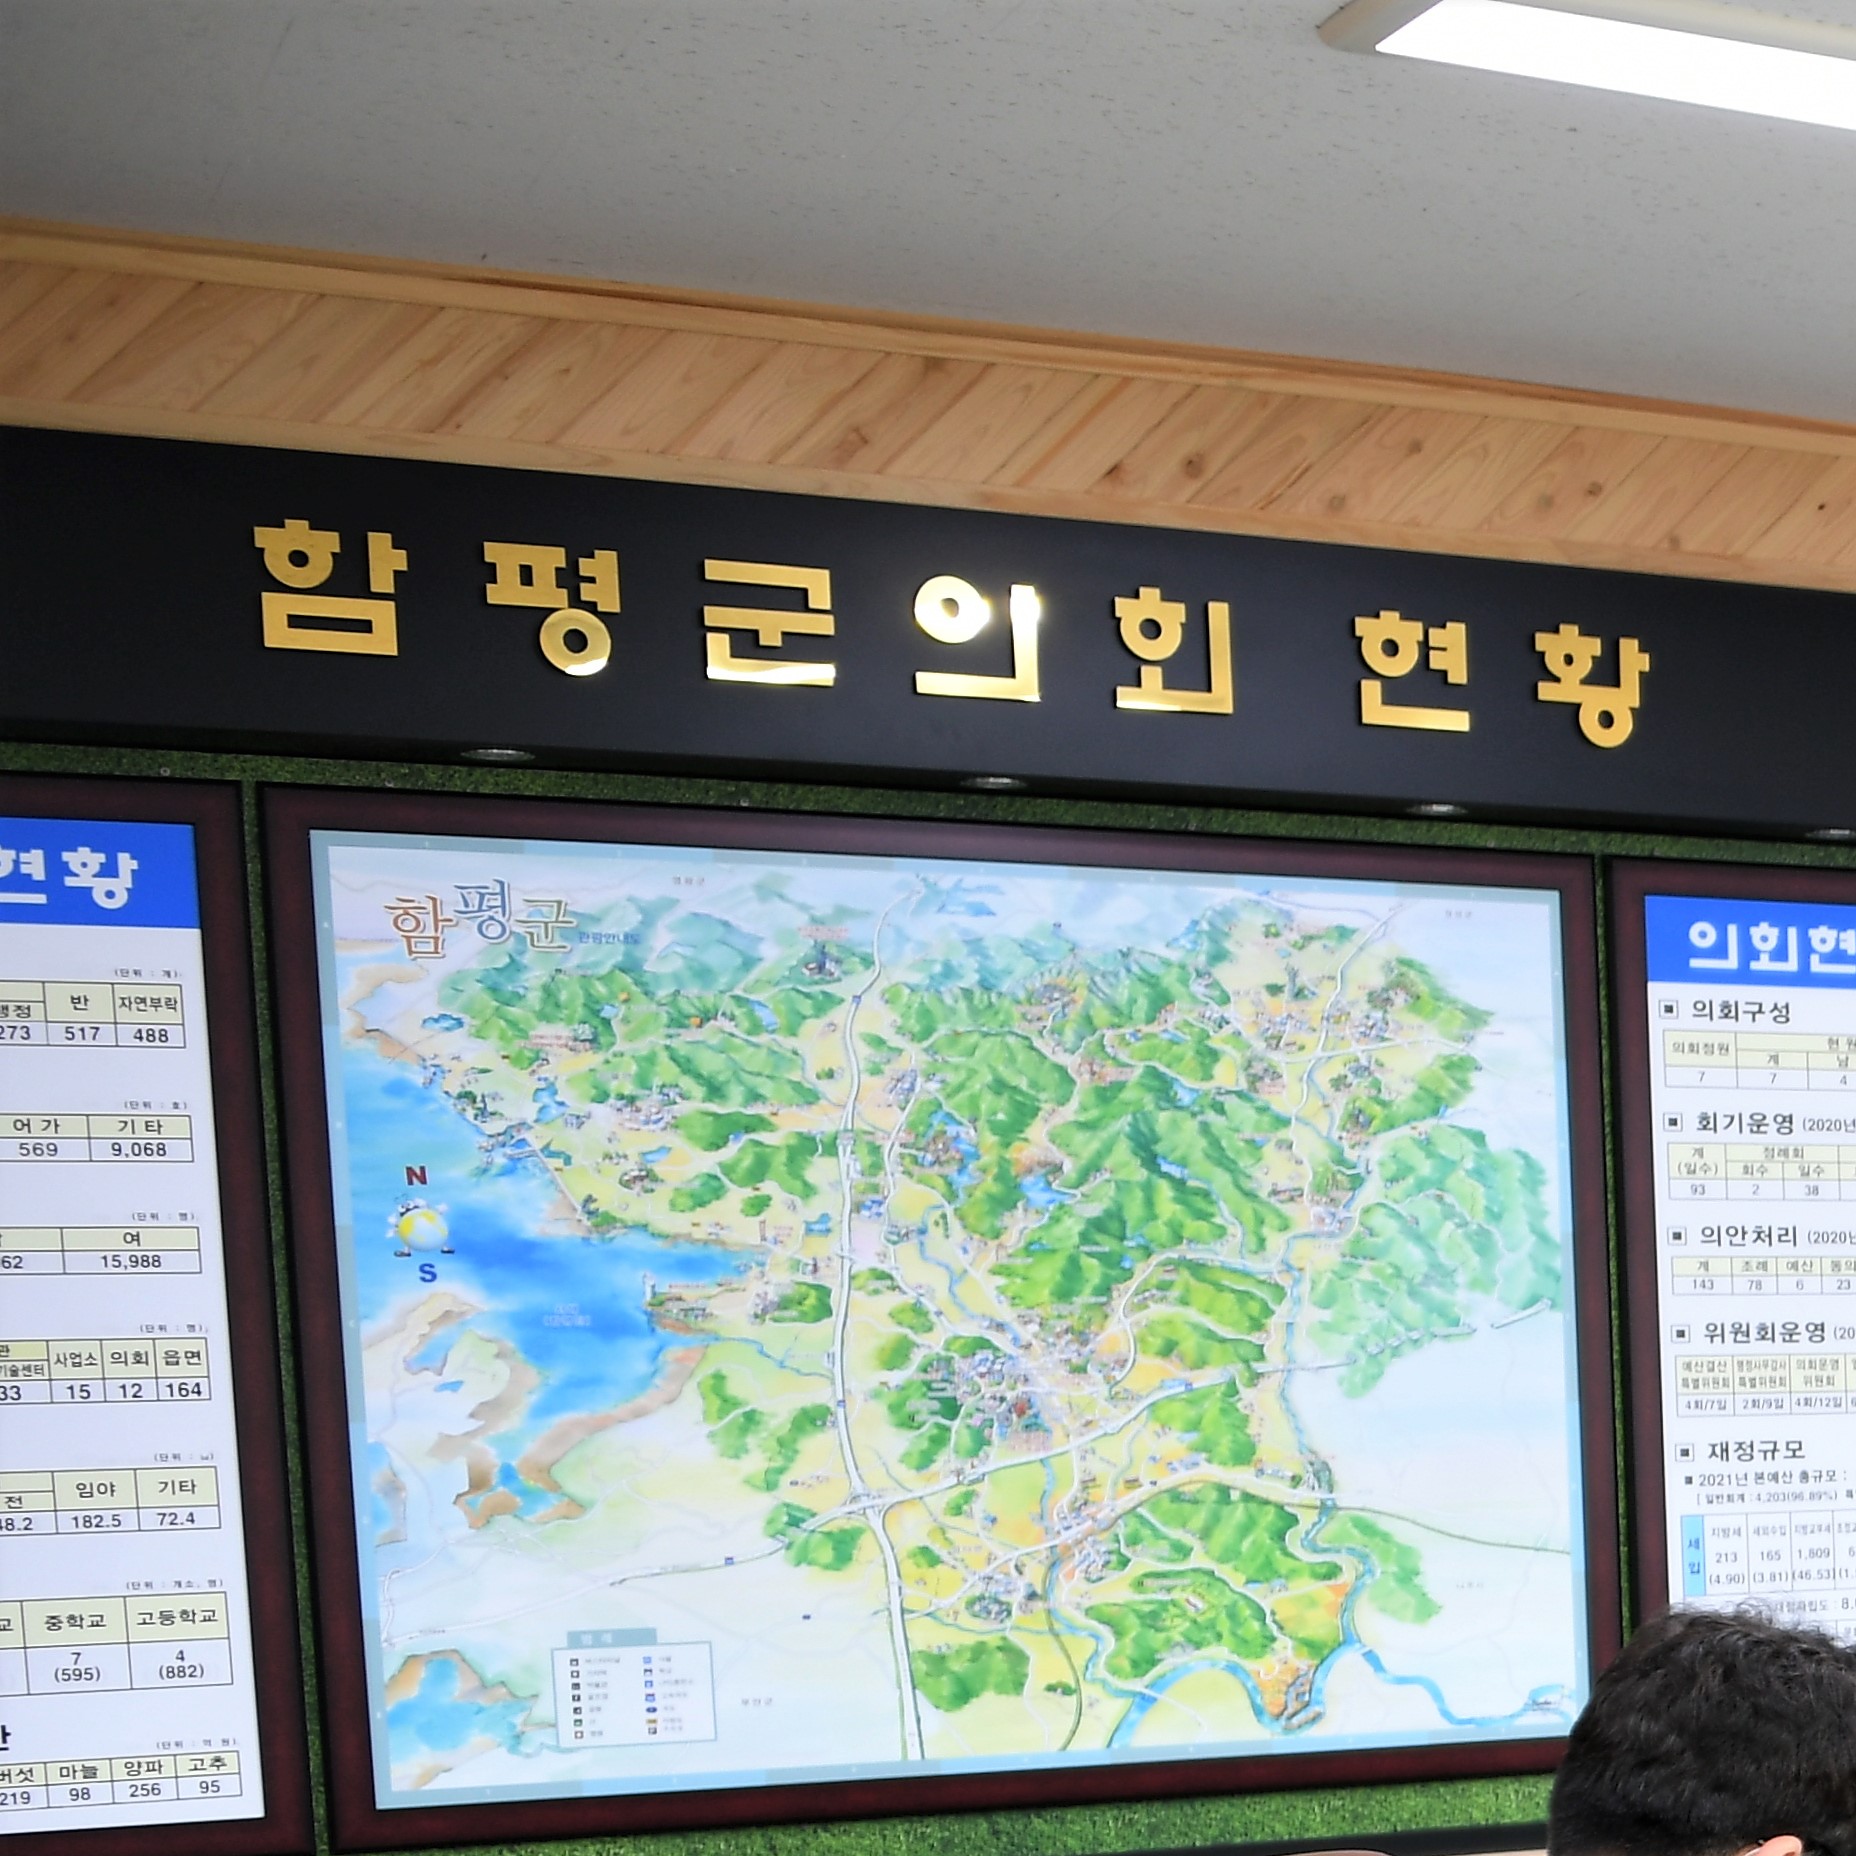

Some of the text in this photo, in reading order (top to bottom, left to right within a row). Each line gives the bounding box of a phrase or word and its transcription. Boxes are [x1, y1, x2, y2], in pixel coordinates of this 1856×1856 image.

[254, 520, 1652, 748] 함평군의회 현황
[383, 878, 578, 960] 함평군
[71, 995, 89, 1011] 반
[119, 996, 178, 1012] 자연부락
[1692, 1000, 1791, 1024] 의회구성
[65, 1026, 100, 1040] 517
[133, 1028, 169, 1043] 488
[1839, 1074, 1848, 1086] 4
[1696, 1111, 1794, 1134] 회기운영
[19, 1142, 58, 1156] 569
[111, 1142, 167, 1158] 9,068
[406, 1165, 428, 1186] N
[1690, 1184, 1706, 1196] 93
[1752, 1184, 1760, 1196] 2
[1805, 1184, 1819, 1196] 38
[123, 1231, 141, 1247] 여
[1700, 1225, 1798, 1248] 의안처리
[101, 1255, 162, 1269] 15,988
[419, 1263, 437, 1282] S
[1692, 1279, 1714, 1290] 143
[1748, 1279, 1762, 1290] 78
[1836, 1279, 1851, 1290] 23
[1704, 1321, 1826, 1344] 위원회운영
[54, 1353, 98, 1368] 사업소
[110, 1350, 149, 1367] 의회
[162, 1350, 201, 1366] 읍면
[66, 1384, 91, 1399] 15
[119, 1384, 143, 1399] 12
[165, 1382, 202, 1398] 164
[1708, 1440, 1806, 1462] 재정규모
[158, 1480, 197, 1495] 기타
[1698, 1474, 1748, 1487] 2021년
[75, 1482, 115, 1498] 임야
[4, 1496, 23, 1509] 전
[71, 1515, 122, 1529] 182.5
[157, 1512, 195, 1526] 72.4
[1715, 1552, 1738, 1563] 213
[1760, 1550, 1781, 1561] 165
[45, 1614, 107, 1632] 중학교
[137, 1608, 218, 1626] 고등학교
[71, 1652, 82, 1665] 7
[175, 1650, 185, 1662] 4
[54, 1668, 101, 1683] (595)
[159, 1664, 204, 1680] (882)
[59, 1764, 99, 1779] 마늘
[124, 1760, 163, 1776] 양파
[188, 1756, 228, 1772] 고추
[69, 1787, 91, 1801] 98
[129, 1783, 162, 1798] 256
[199, 1780, 220, 1794] 95
